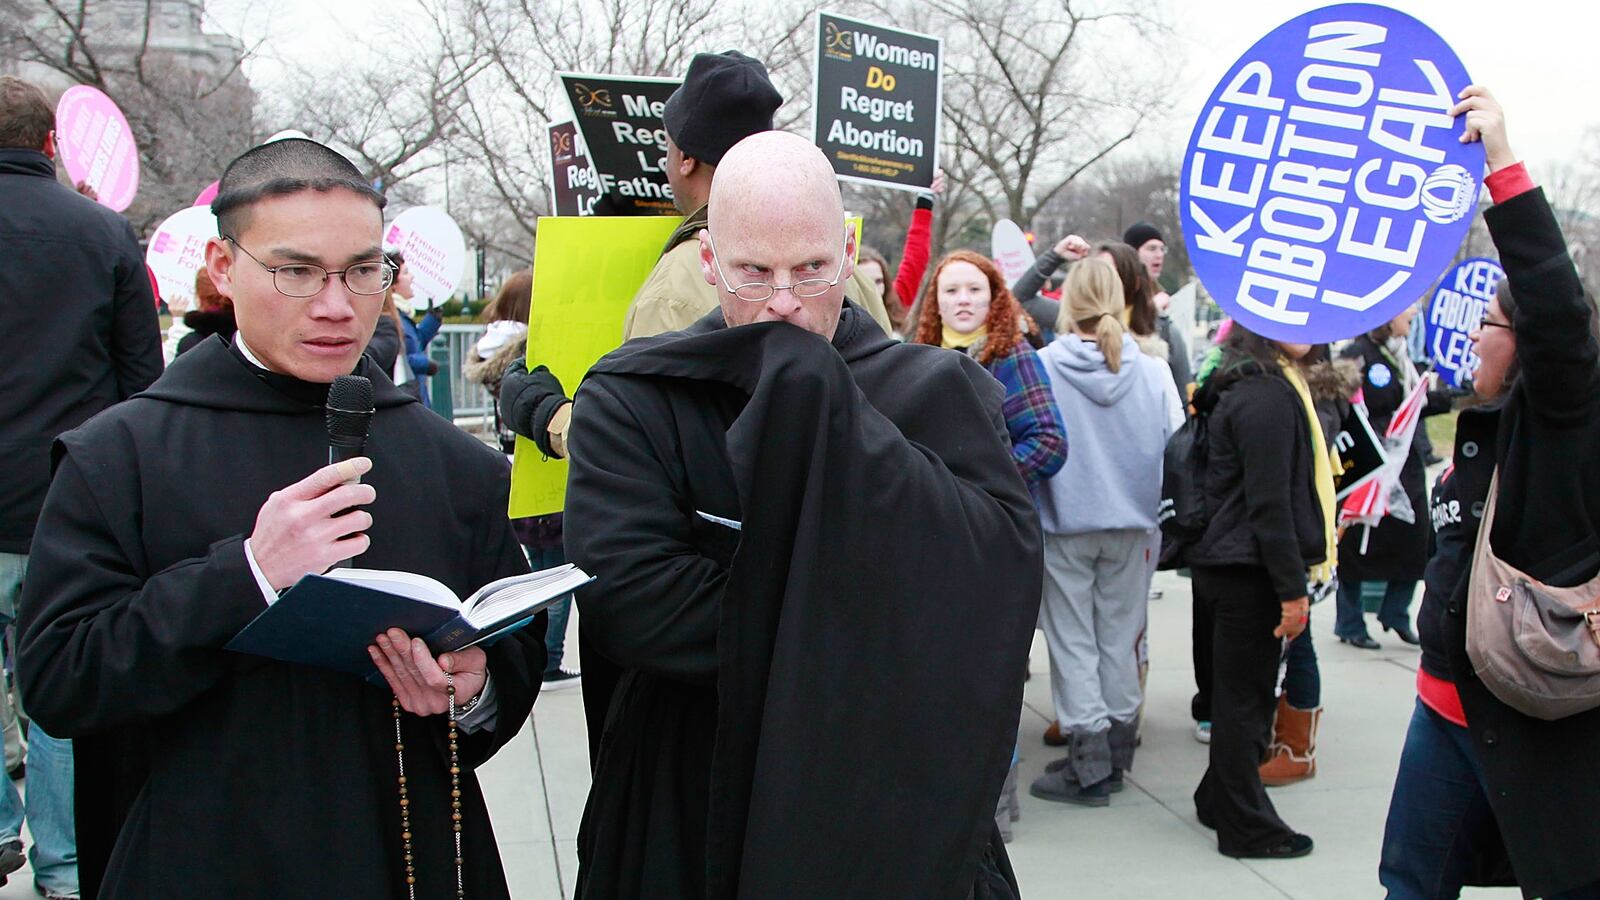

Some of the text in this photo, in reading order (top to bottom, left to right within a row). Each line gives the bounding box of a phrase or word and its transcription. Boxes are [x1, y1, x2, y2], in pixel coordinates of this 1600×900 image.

[853, 31, 936, 71] Women
[866, 66, 896, 91] Do
[841, 86, 914, 122] Regret
[611, 121, 669, 151] Reg
[827, 119, 923, 158] Abortion
[1189, 60, 1286, 258] KEEP
[1235, 20, 1388, 326] ABORTION
[1320, 58, 1455, 312] LEGAL
[405, 241, 445, 272] MAJORITY
[409, 230, 446, 260] FEMINIST
